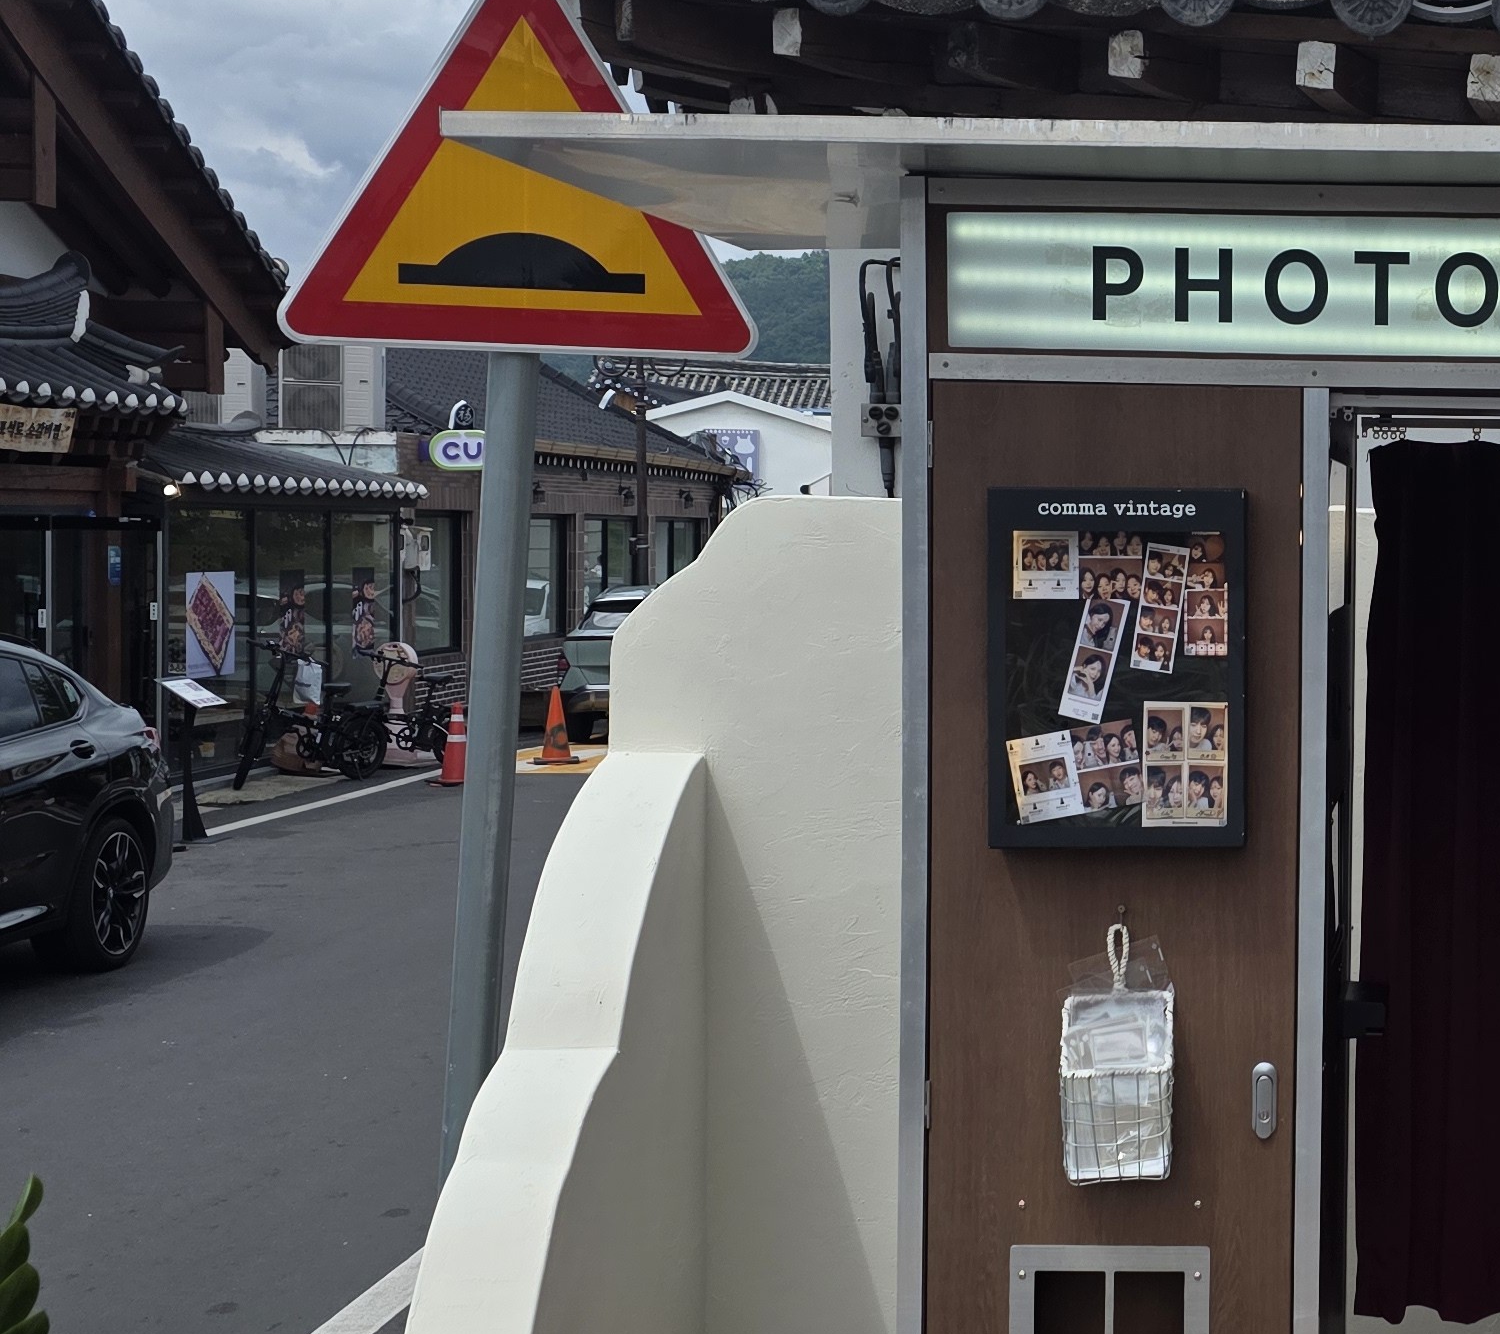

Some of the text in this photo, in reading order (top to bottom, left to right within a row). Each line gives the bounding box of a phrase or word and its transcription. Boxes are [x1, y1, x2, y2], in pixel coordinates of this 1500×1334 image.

[442, 441, 482, 460] CU
[1037, 499, 1196, 519] comma vintage
